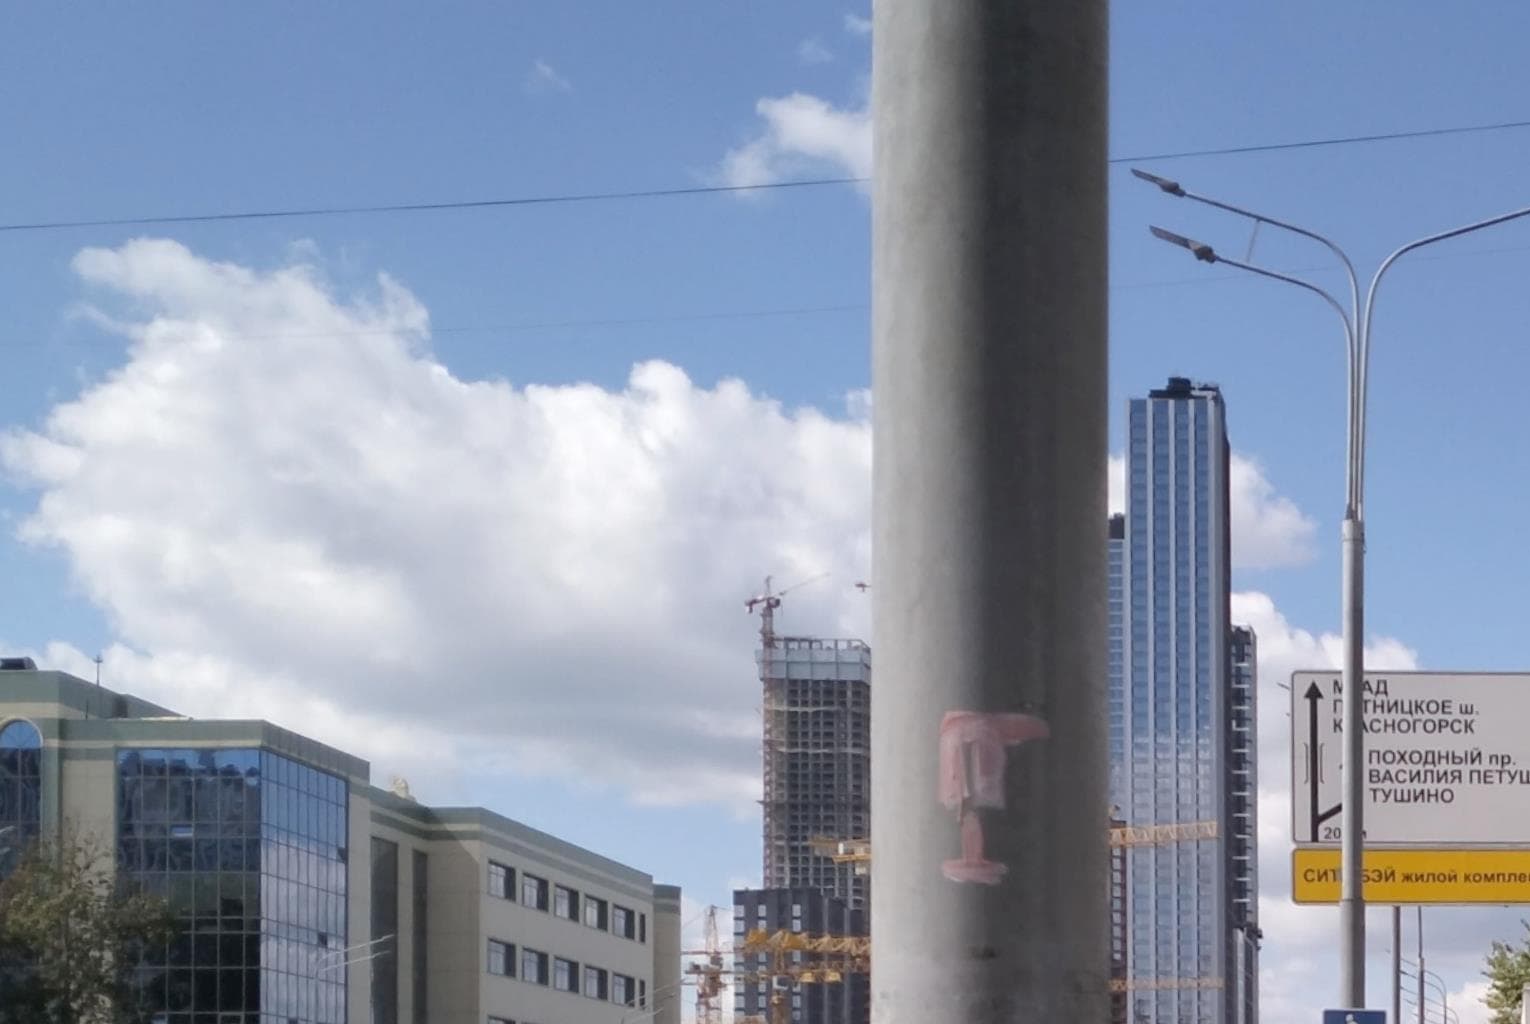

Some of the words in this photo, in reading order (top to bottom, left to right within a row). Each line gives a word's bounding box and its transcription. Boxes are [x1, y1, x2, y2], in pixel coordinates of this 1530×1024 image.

[1333, 679, 1388, 696] МАД
[1333, 699, 1453, 717] ПТНИЦКОЕ
[1368, 747, 1483, 767] ПОХОДНЫЙ
[1489, 753, 1516, 770] пр.
[1368, 768, 1462, 785] ВАСИЛИЯ
[1371, 787, 1455, 804] ТУШИНО
[1303, 868, 1342, 883] СИТ
[1402, 868, 1458, 884] жилой
